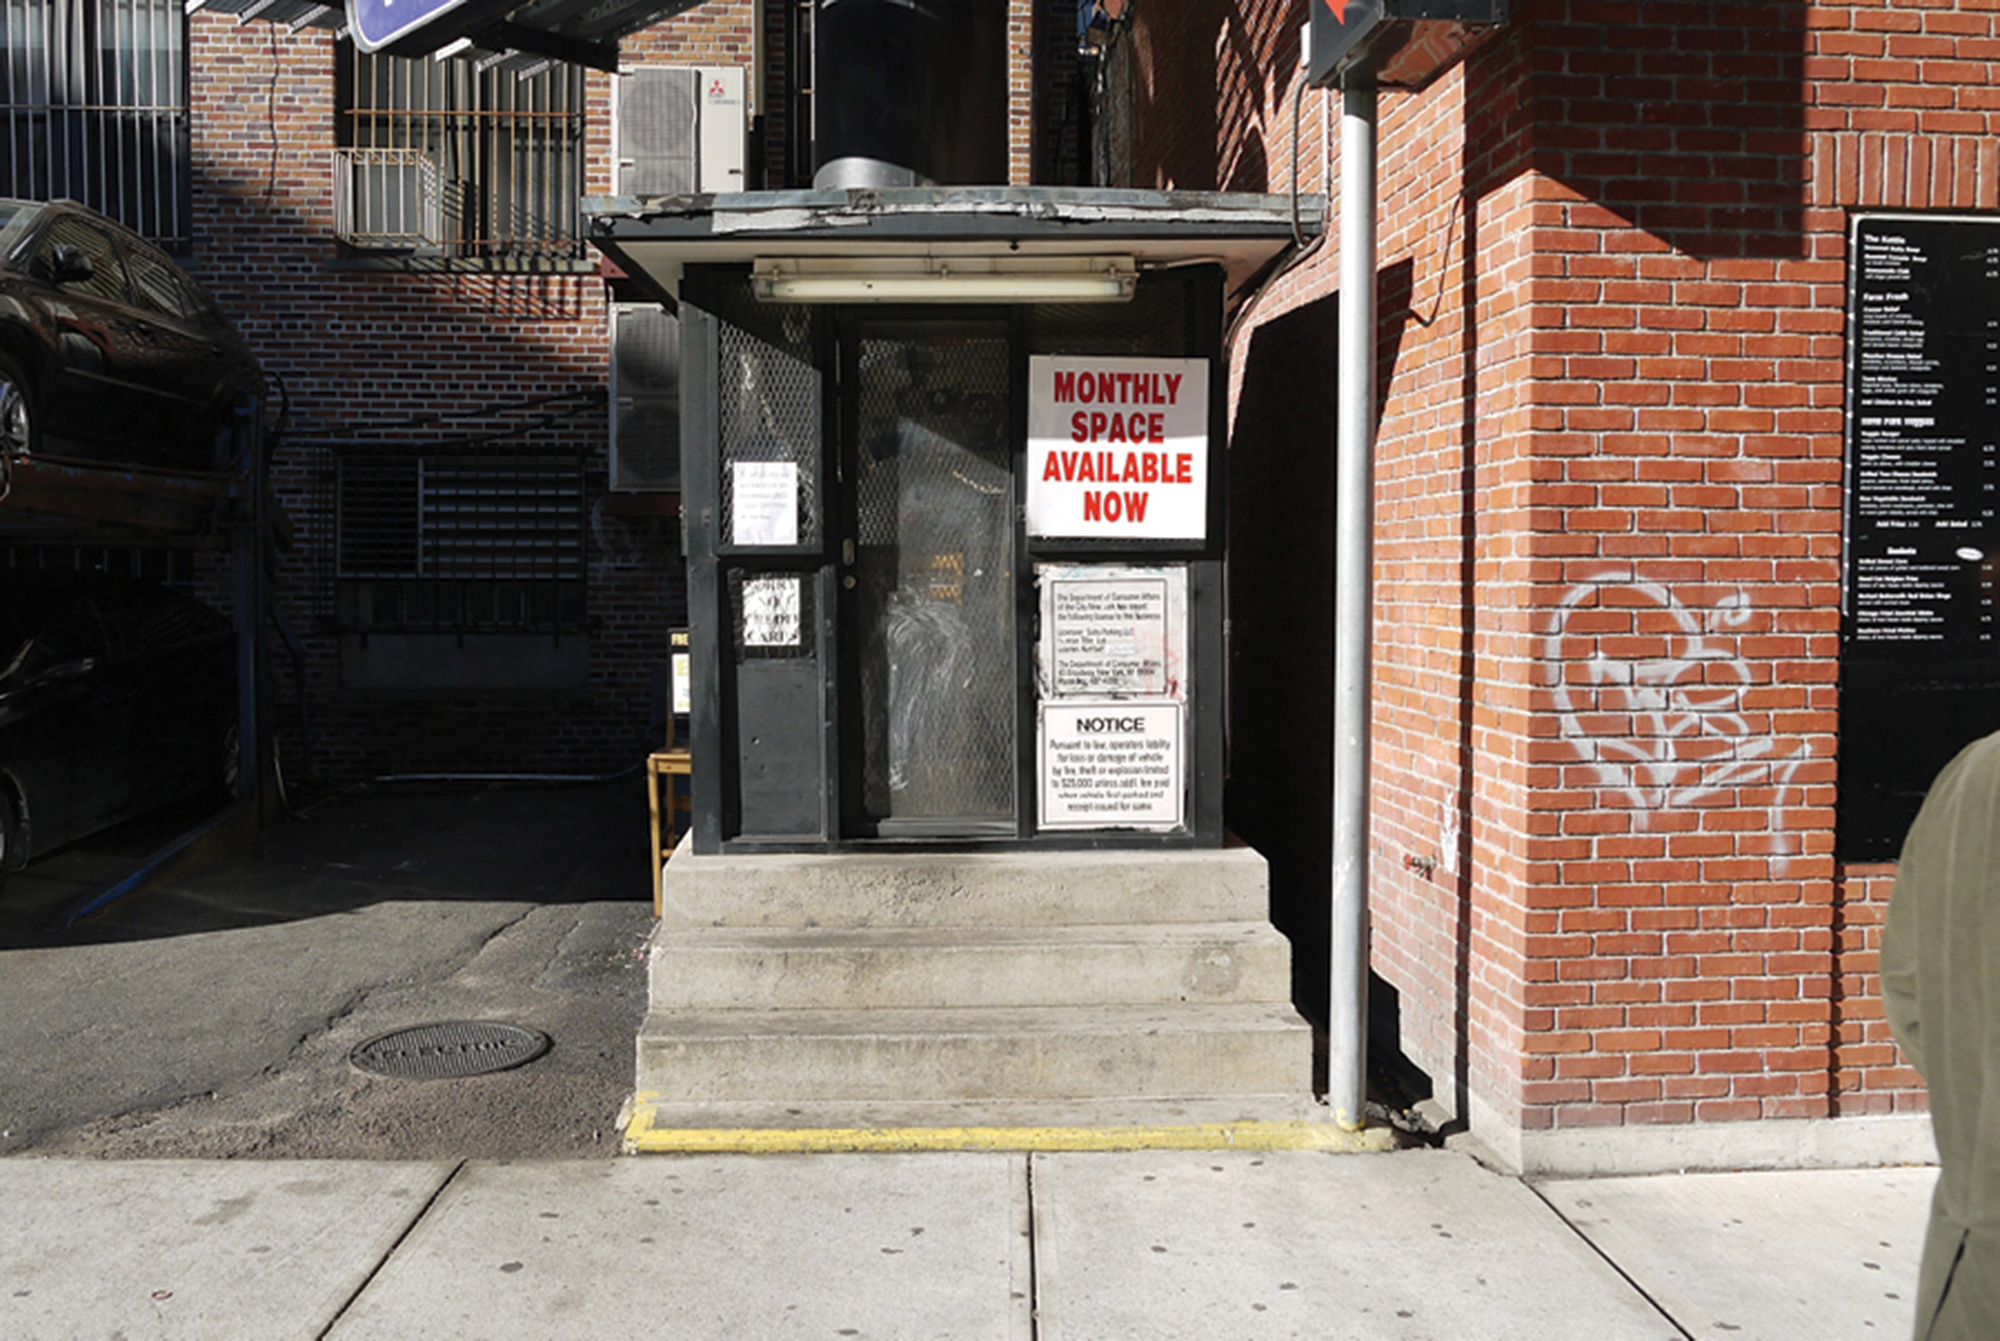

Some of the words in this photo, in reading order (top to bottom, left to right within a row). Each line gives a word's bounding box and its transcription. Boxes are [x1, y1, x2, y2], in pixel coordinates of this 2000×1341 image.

[1054, 371, 1182, 404] MONTHLY
[1071, 411, 1164, 444] SPACE
[1043, 450, 1192, 483] AVAILABLE
[1084, 491, 1148, 522] NOW
[1076, 717, 1145, 732] NOTICE
[1050, 740, 1082, 749] Pursuant
[1084, 740, 1091, 749] to
